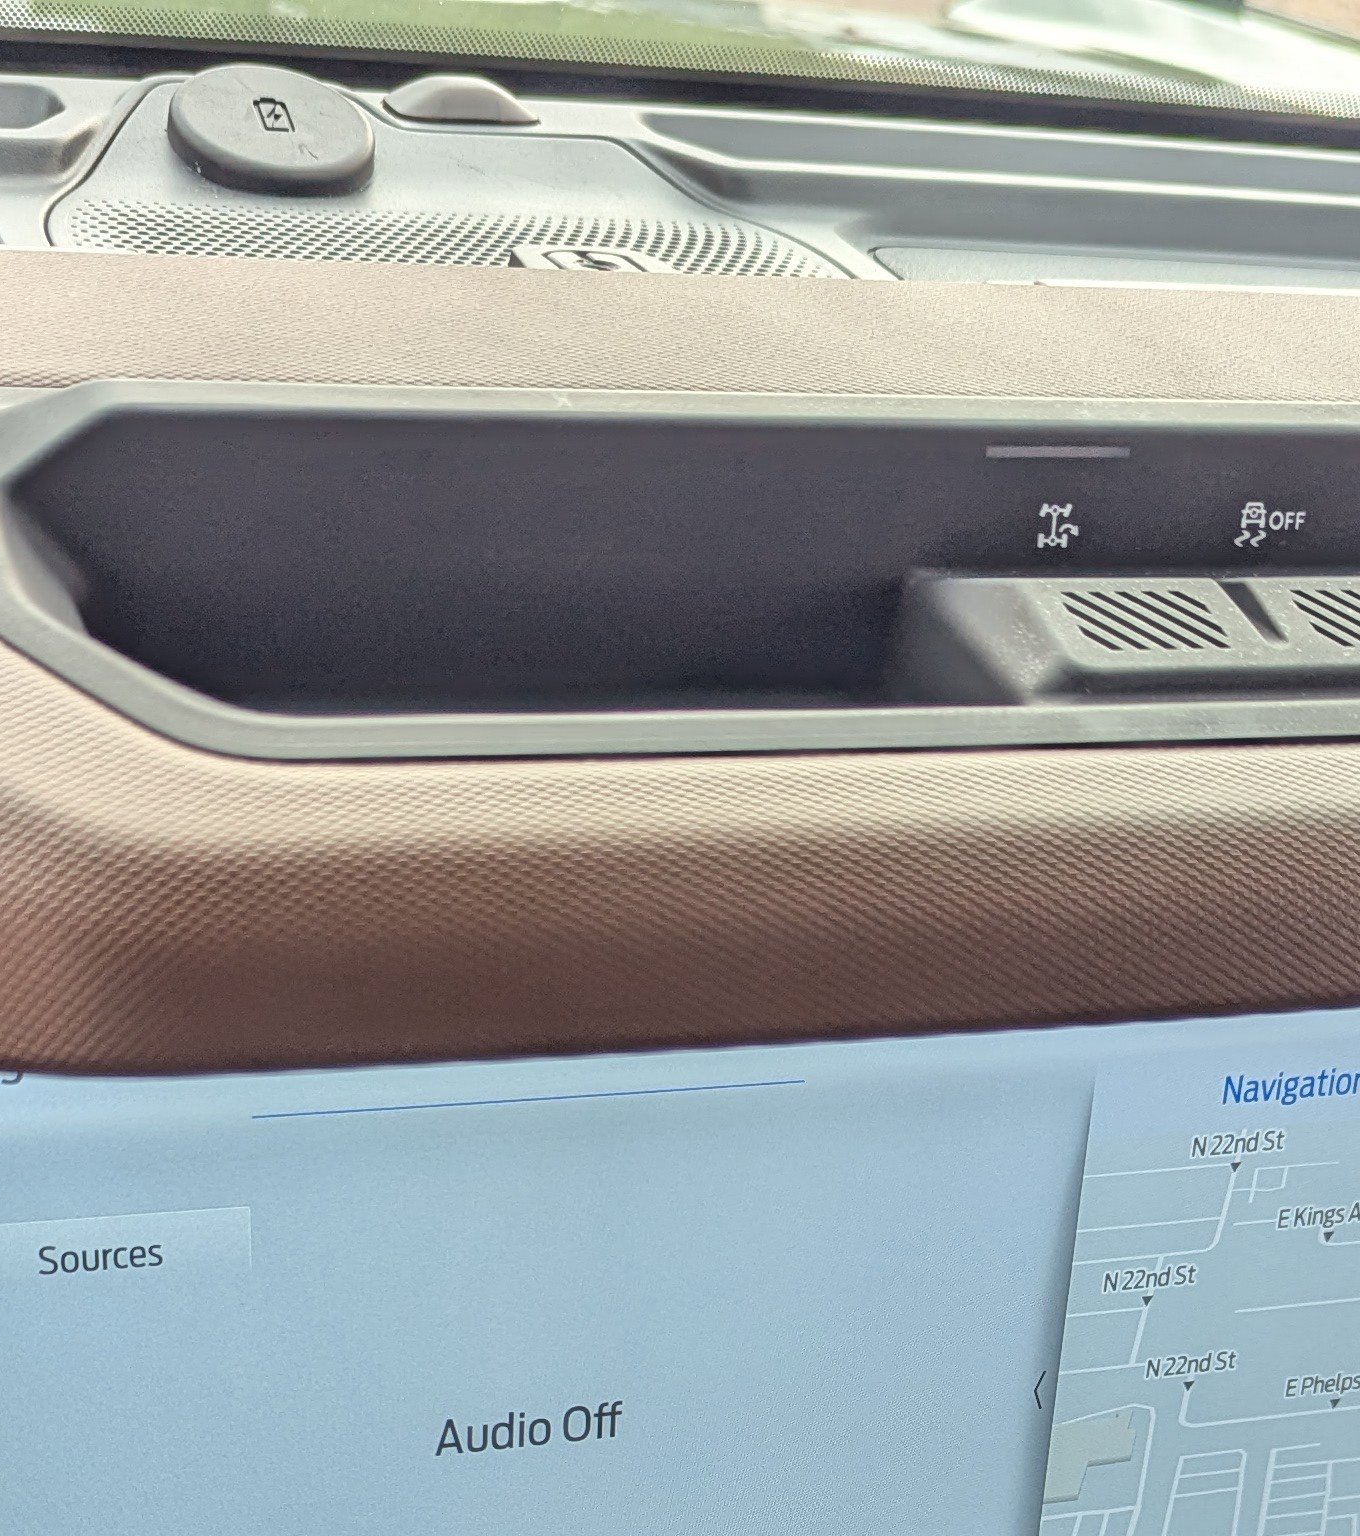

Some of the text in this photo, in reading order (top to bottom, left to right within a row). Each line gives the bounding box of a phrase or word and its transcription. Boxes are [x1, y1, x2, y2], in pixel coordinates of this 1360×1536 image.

[1269, 510, 1307, 531] OFF
[1191, 1130, 1286, 1158] N 22nd St
[1277, 1208, 1291, 1230] E
[1292, 1203, 1344, 1230] Kings
[38, 1242, 164, 1276] Sources
[1102, 1265, 1197, 1294] N 22nd St
[1145, 1350, 1237, 1379] N 22nd St
[1284, 1377, 1298, 1398] E
[435, 1400, 623, 1457] Audio Off
